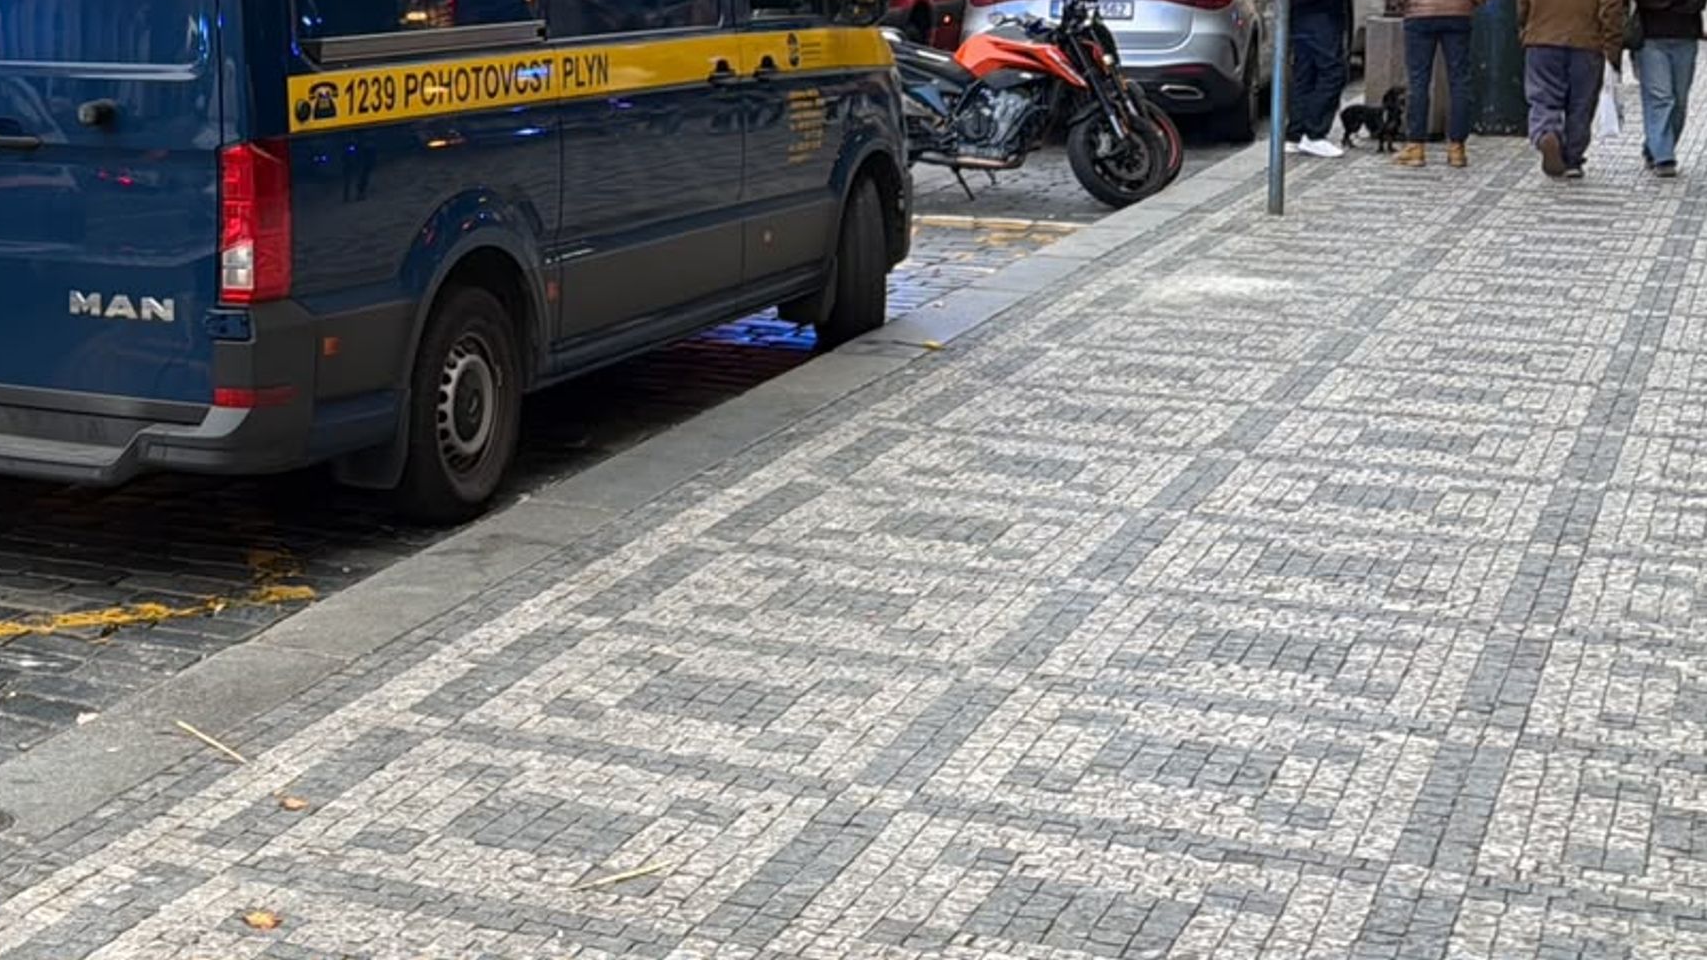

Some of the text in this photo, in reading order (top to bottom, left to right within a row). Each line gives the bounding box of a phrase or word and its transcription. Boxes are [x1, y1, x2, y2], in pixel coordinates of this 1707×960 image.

[344, 53, 609, 116] 1239 POHOTOVOST PLYN
[69, 289, 174, 322] MAN
